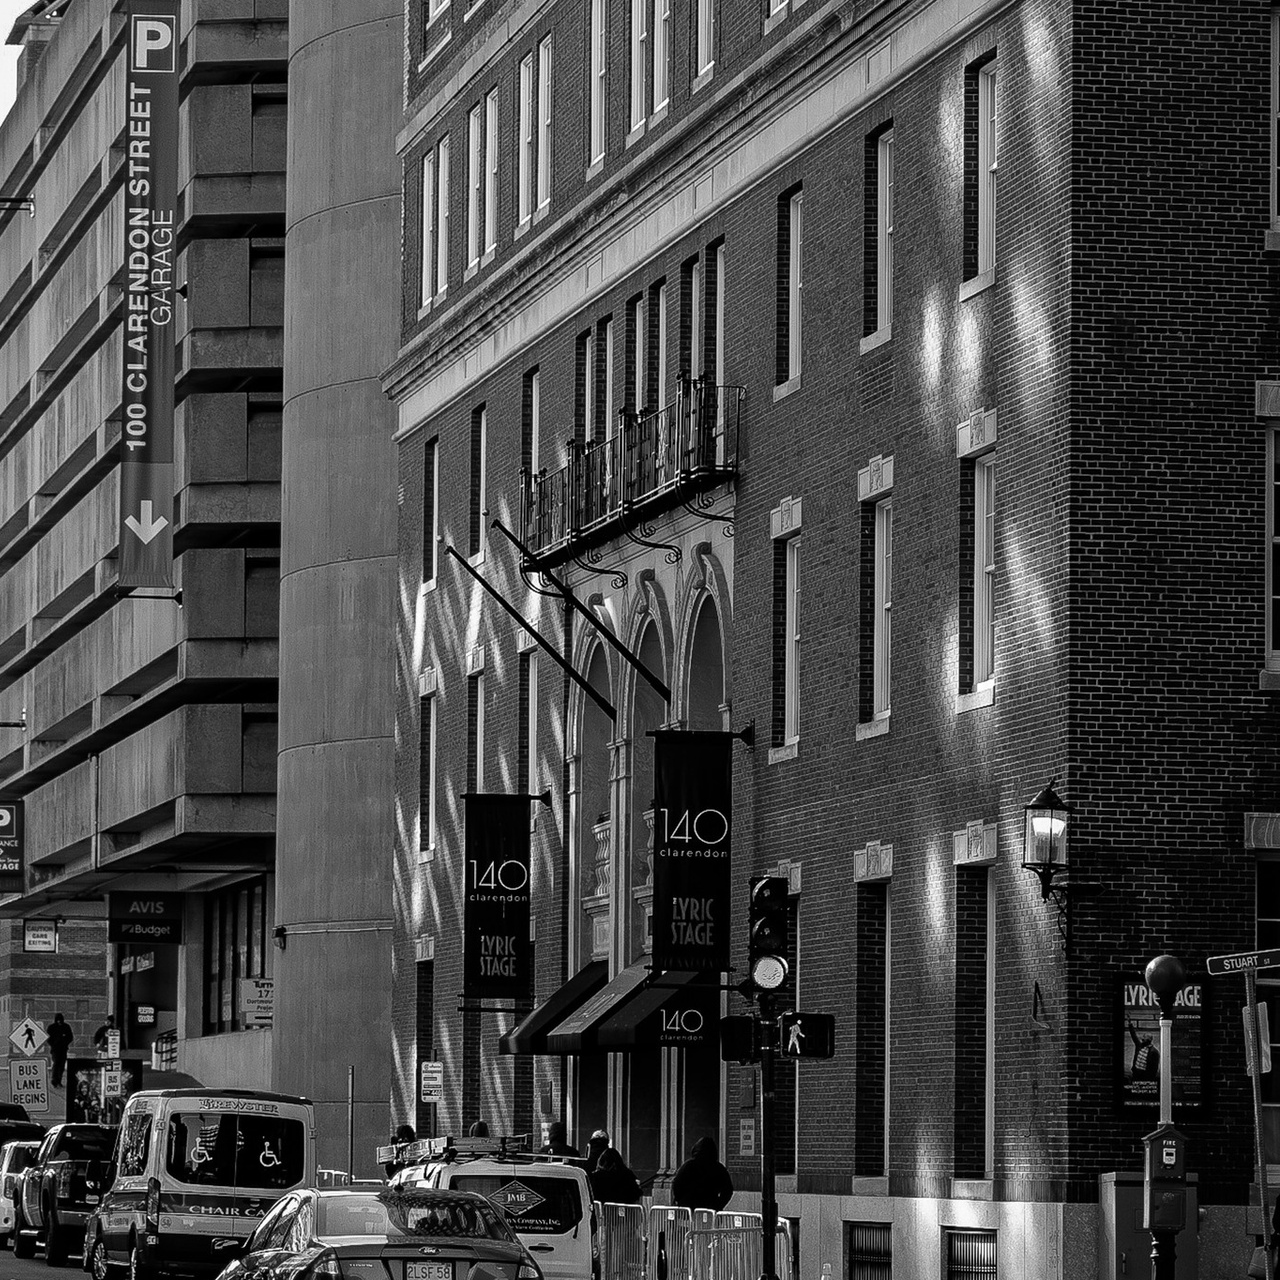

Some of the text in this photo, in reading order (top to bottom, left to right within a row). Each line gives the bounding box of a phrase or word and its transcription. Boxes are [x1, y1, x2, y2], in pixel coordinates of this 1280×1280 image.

[136, 20, 170, 68] P
[126, 81, 151, 452] 100 CLARENDON STREET
[151, 209, 173, 325] GARAGE
[660, 808, 729, 844] 140
[660, 849, 729, 859] clarendon
[469, 860, 528, 891] 140
[470, 893, 528, 902] clarendon
[129, 901, 164, 914] AVIS
[673, 898, 715, 921] LYRIC
[134, 924, 171, 937] Budget
[671, 922, 715, 946] STAGE
[481, 935, 517, 956] LYRIC
[479, 956, 518, 977] STAGE
[1223, 955, 1259, 970] STUART
[1172, 985, 1202, 1007] AGE
[660, 1008, 704, 1033] 140
[660, 1034, 704, 1042] clarendon
[19, 1065, 39, 1076] BUS
[16, 1079, 42, 1090] LANE
[13, 1093, 47, 1105] BEGINS
[507, 1193, 526, 1203] JMB
[189, 1205, 267, 1217] CHAIR CA
[407, 1266, 451, 1279] 2LSF 58
